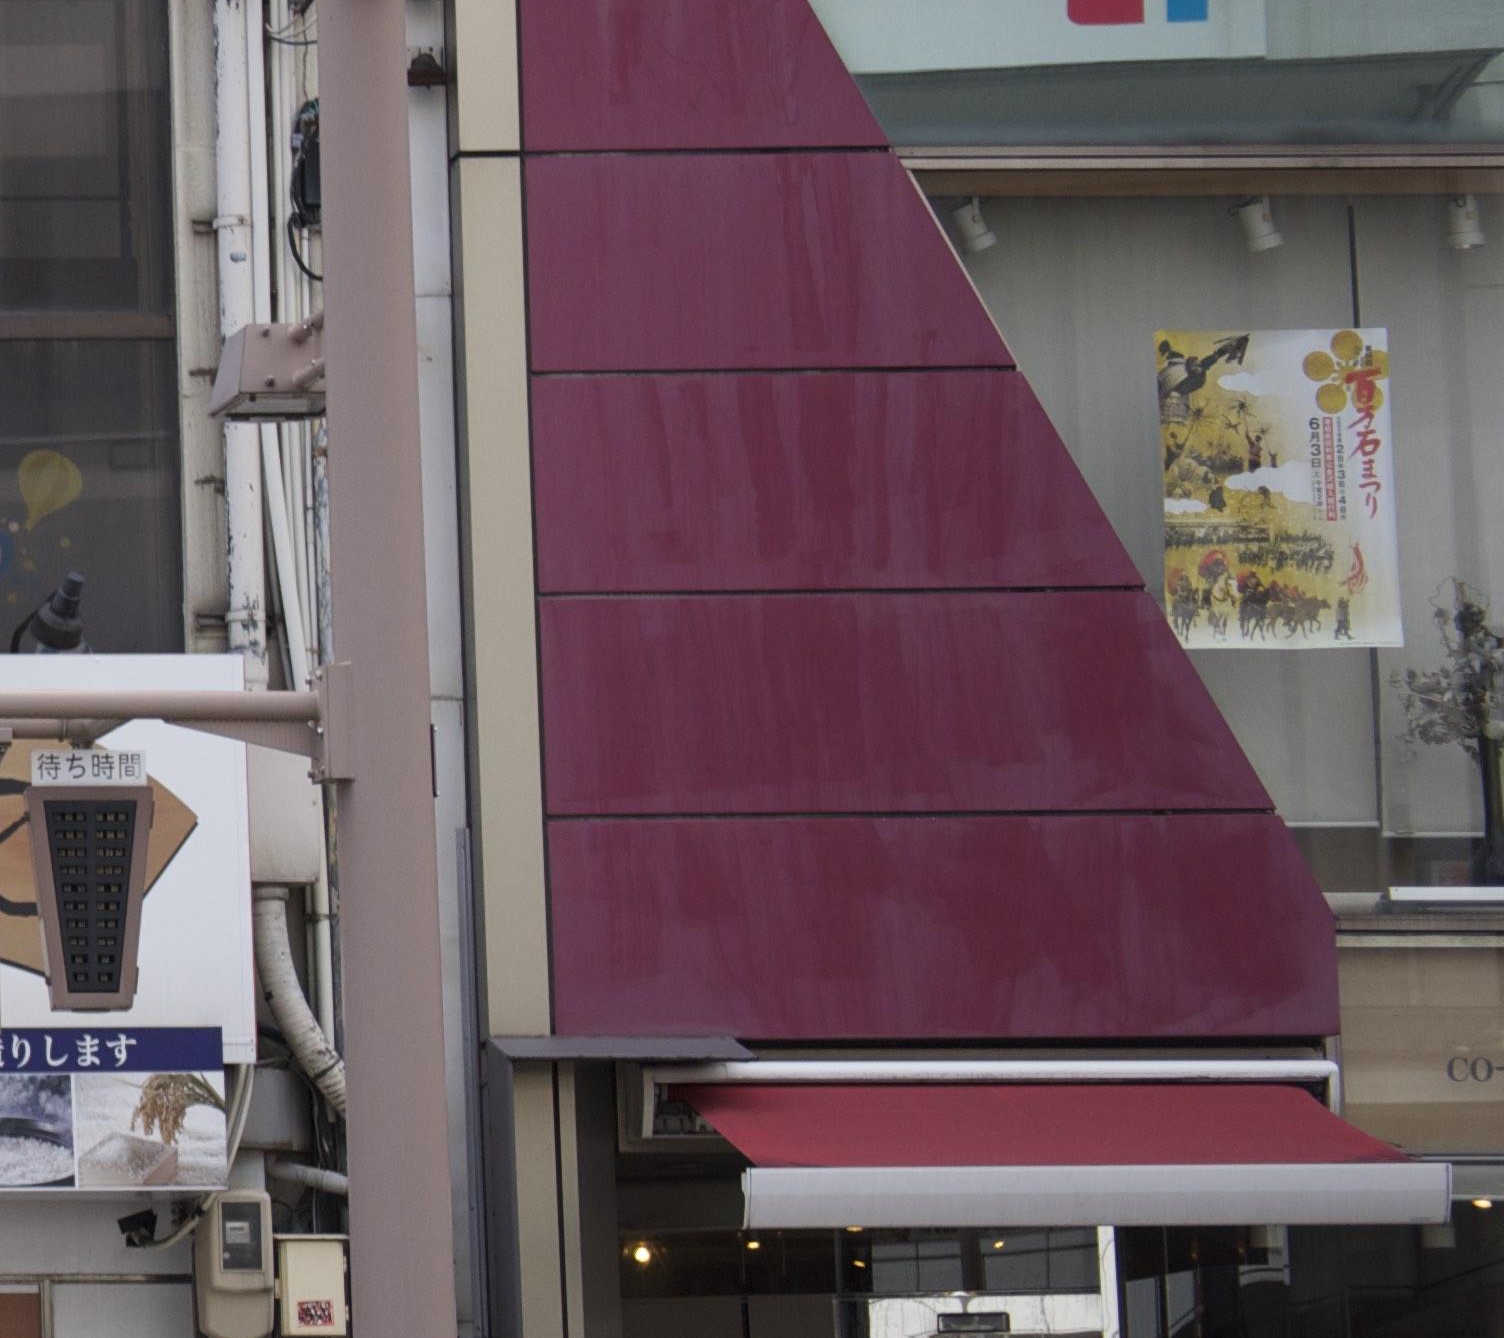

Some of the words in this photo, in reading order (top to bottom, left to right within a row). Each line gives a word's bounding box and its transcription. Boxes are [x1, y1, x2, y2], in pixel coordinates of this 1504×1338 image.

[1344, 366, 1383, 520] 百万石まつり
[37, 753, 142, 781] 待ち時間
